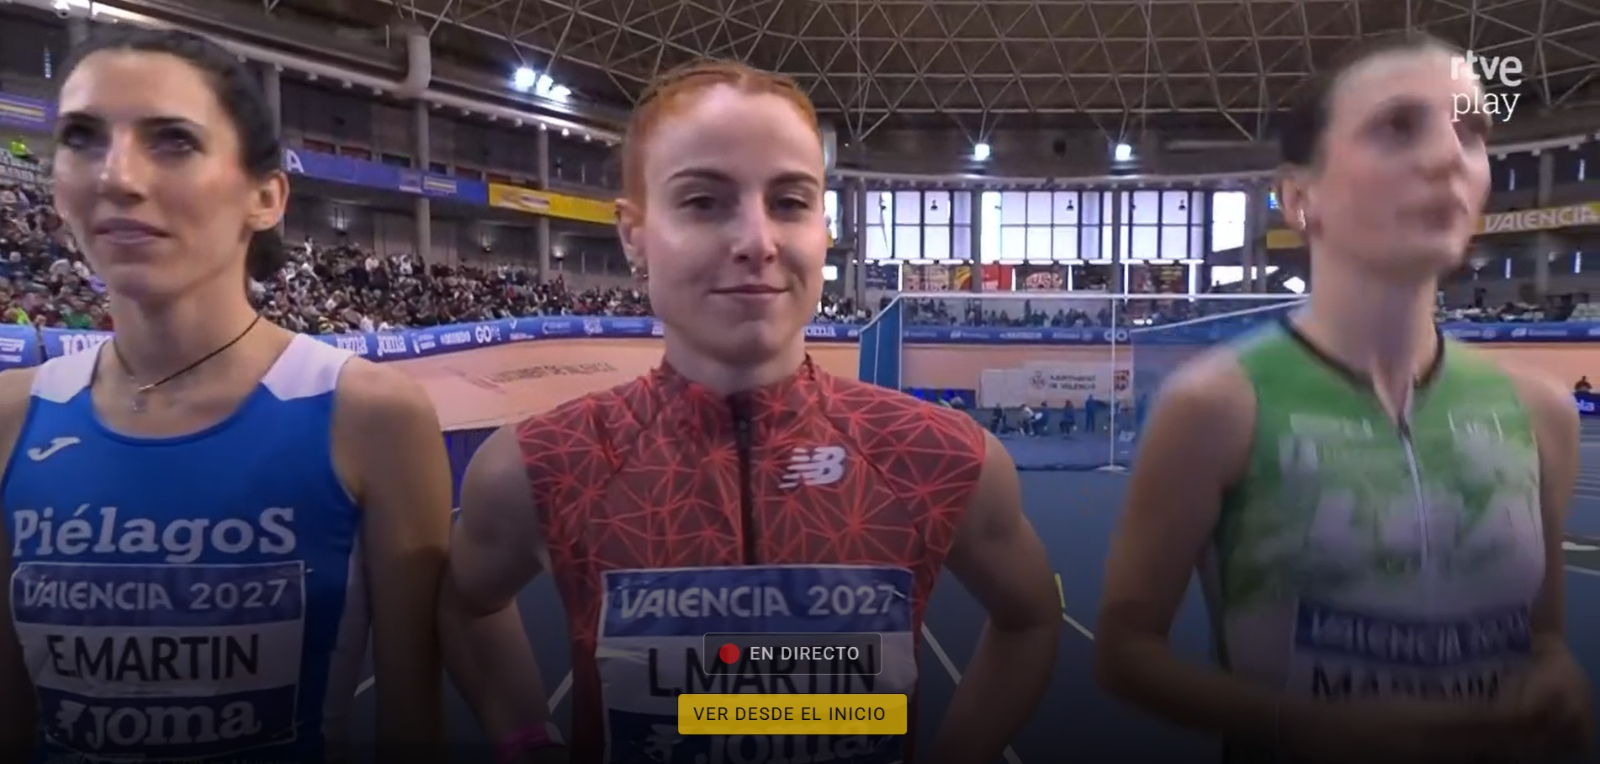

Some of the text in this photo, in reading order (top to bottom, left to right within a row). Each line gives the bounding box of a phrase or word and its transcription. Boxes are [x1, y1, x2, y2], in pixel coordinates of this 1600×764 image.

[1485, 203, 1600, 233] VALENCIA
[23, 577, 288, 611] VALENCIA 2027
[619, 585, 896, 619] VALENCIA 2027
[85, 700, 262, 750] Joma
